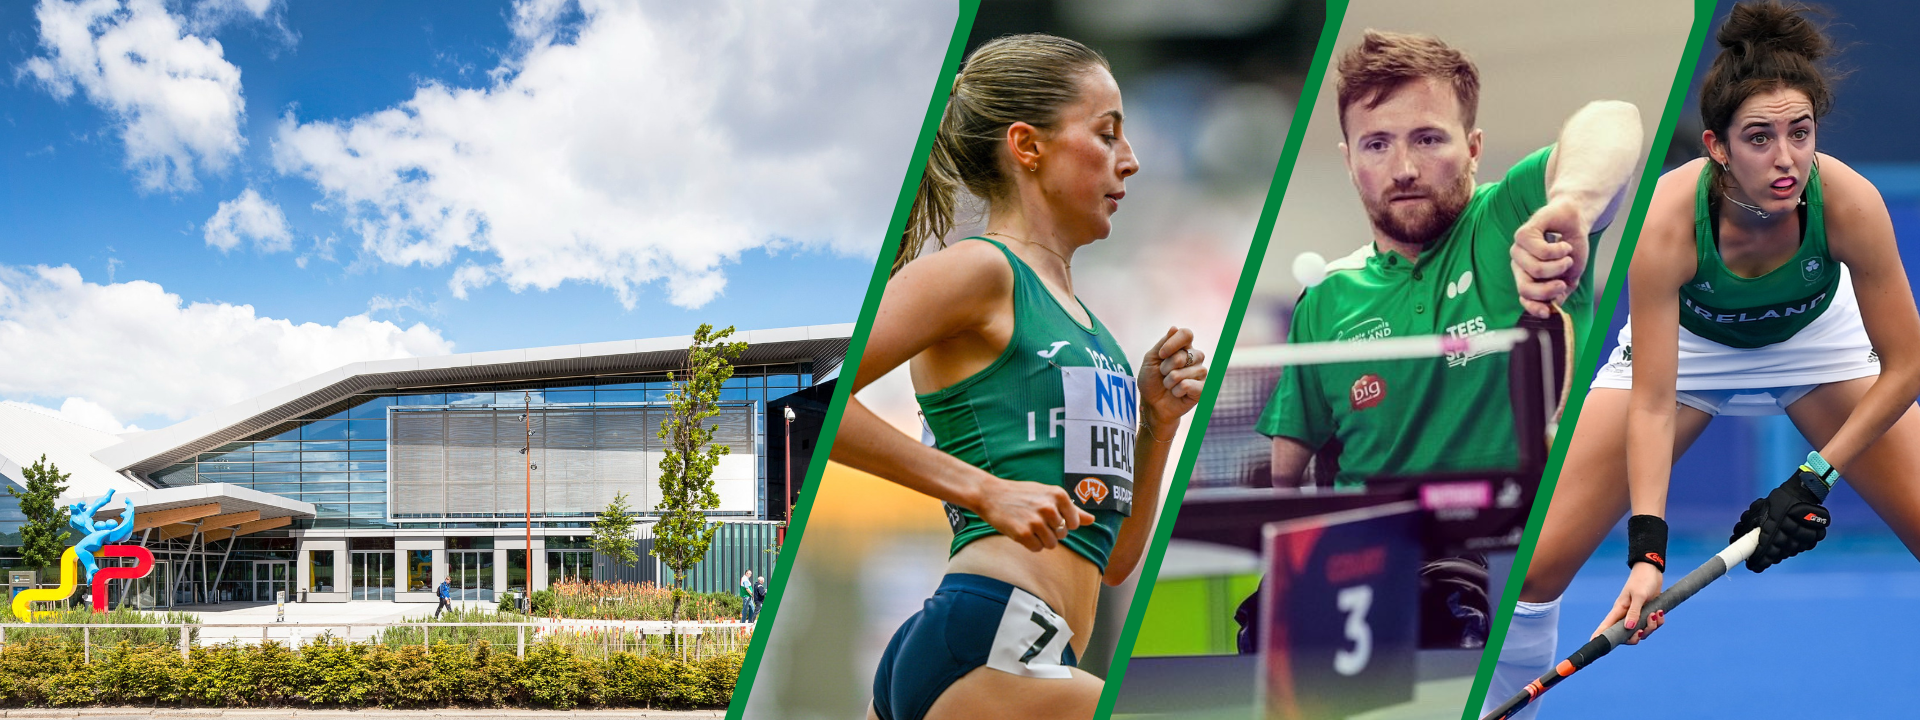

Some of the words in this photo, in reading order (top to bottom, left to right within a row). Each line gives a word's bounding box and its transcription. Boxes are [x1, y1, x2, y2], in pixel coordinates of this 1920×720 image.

[1686, 292, 1826, 323] IRELAND
[1446, 316, 1486, 341] TEES
[1353, 381, 1381, 401] big
[1027, 406, 1066, 441] IR
[1018, 610, 1059, 666] 7
[1333, 584, 1373, 676] 3
